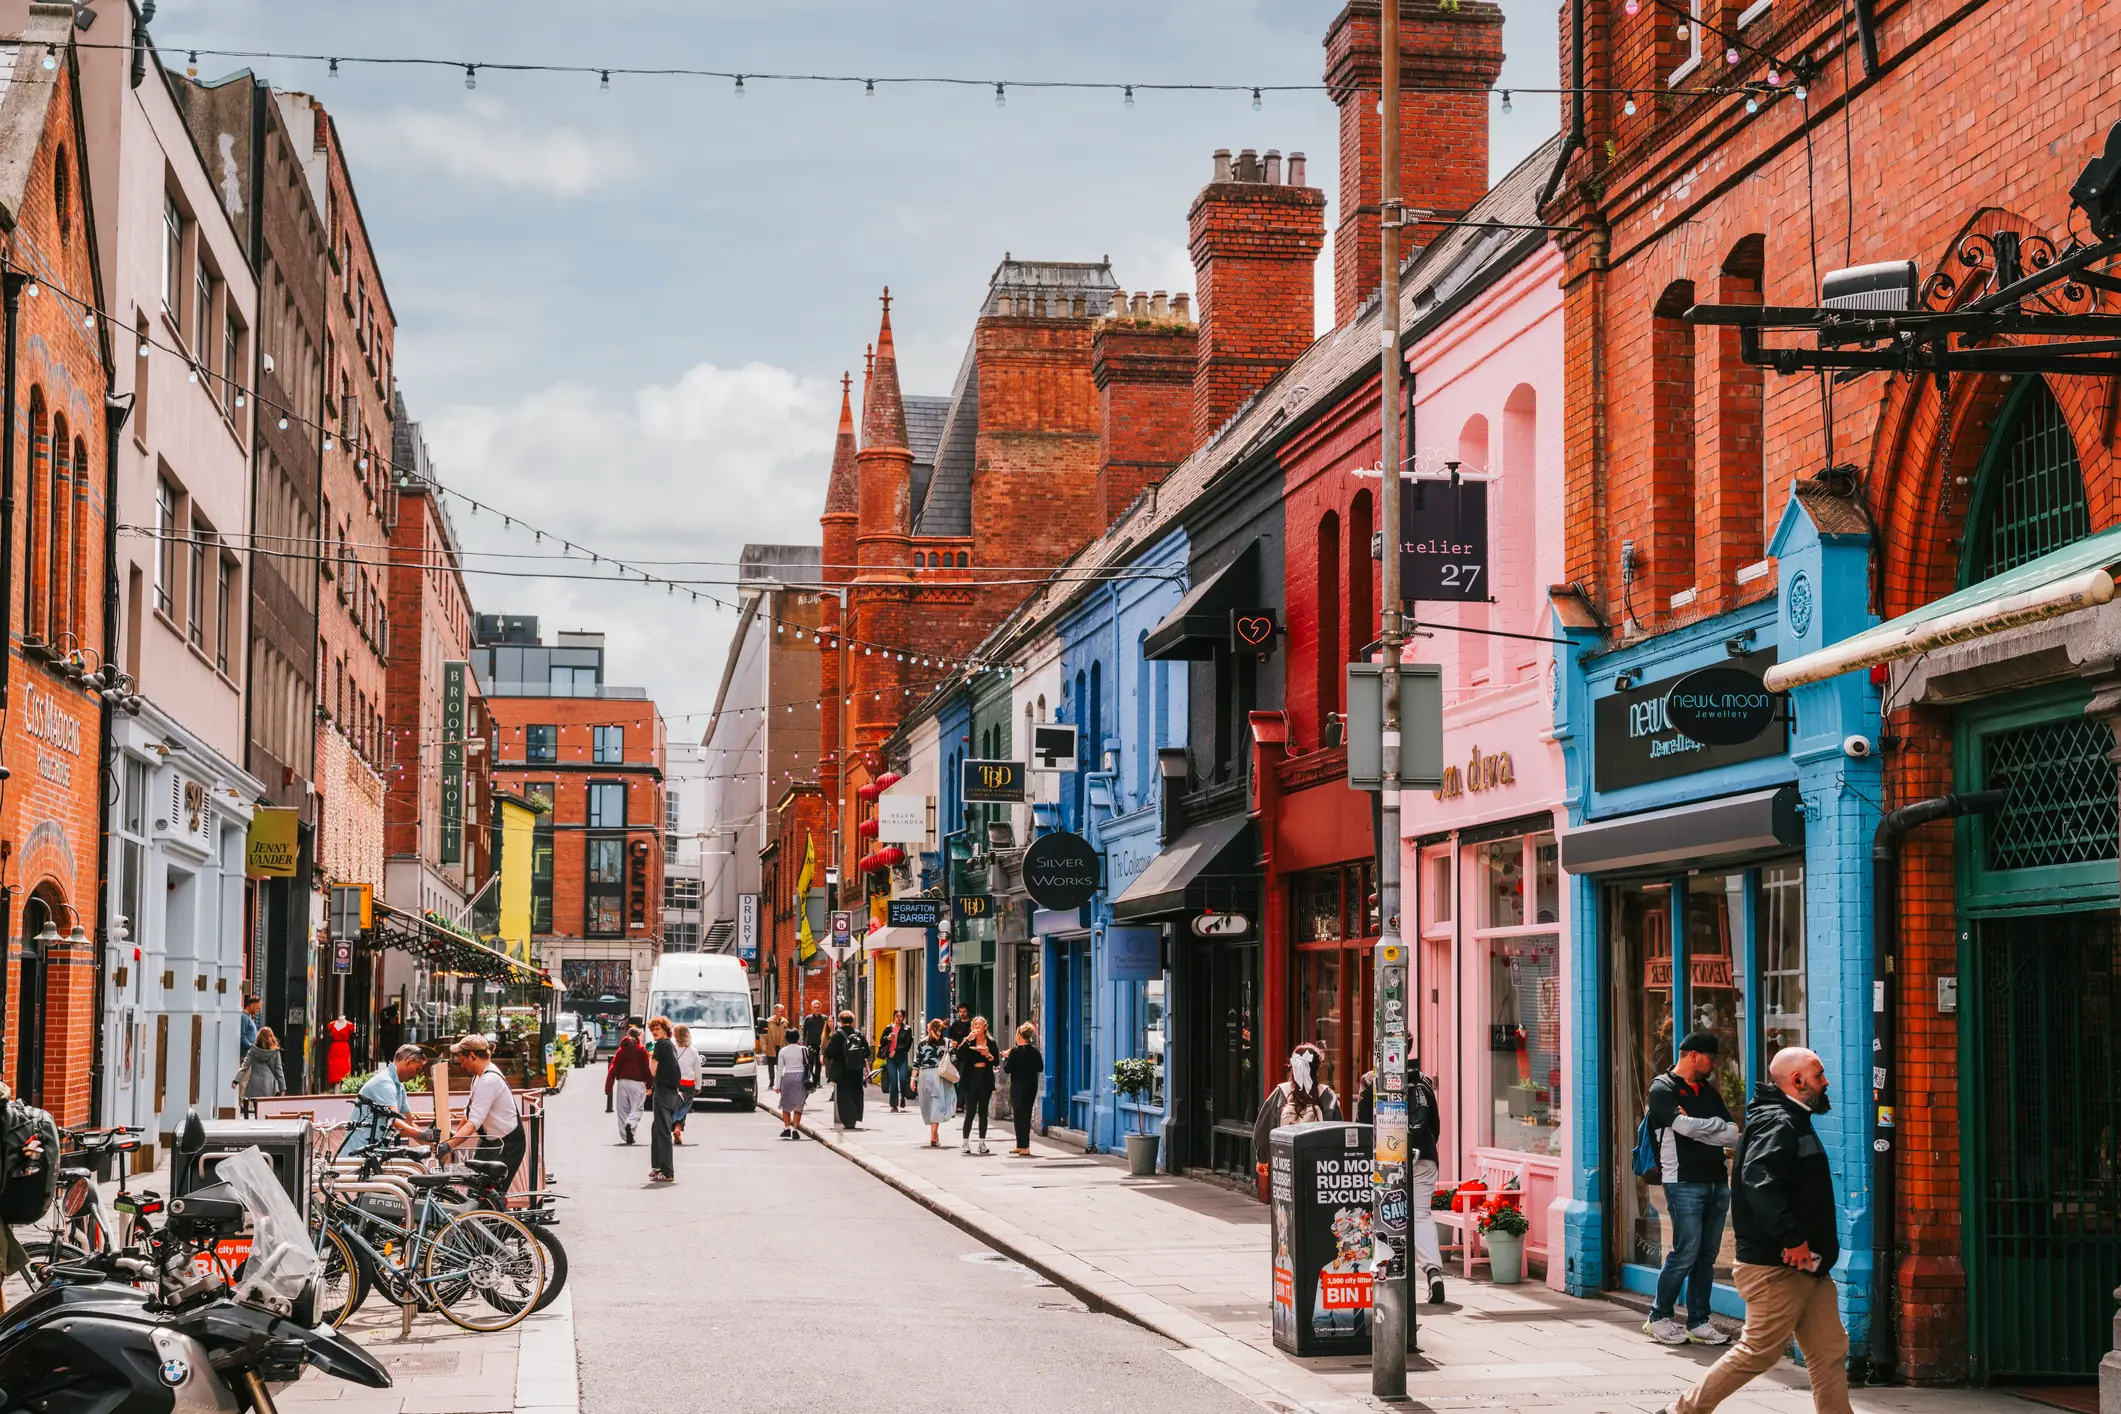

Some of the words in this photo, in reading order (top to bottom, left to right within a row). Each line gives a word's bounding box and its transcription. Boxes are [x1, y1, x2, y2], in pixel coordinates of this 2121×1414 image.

[1399, 540, 1473, 554] telier
[1441, 564, 1481, 593] 27
[1673, 695, 1709, 708] new
[1721, 694, 1769, 708] moon
[448, 670, 459, 760] BROOKS
[1630, 697, 1664, 738] new
[1695, 710, 1748, 719] Jewellery
[978, 765, 1012, 789] TBD
[1433, 765, 1462, 800] m
[1467, 744, 1515, 792] diva
[446, 774, 458, 850] HOTEL
[253, 842, 290, 854] JENNY
[249, 854, 293, 866] VANDER
[1036, 856, 1084, 868] SILVER
[1112, 853, 1123, 879] The
[1032, 875, 1093, 887] WORKS
[900, 904, 935, 913] GRAFTON
[959, 897, 985, 916] TBD
[743, 895, 752, 943] DRURY
[900, 913, 936, 923] BARBER
[740, 949, 748, 959] P
[1272, 1156, 1279, 1169] NO
[1278, 1157, 1291, 1172] MORE
[1316, 1160, 1340, 1174] NO
[1343, 1159, 1374, 1173] MO
[1272, 1170, 1291, 1187] RUBBISH
[1316, 1174, 1374, 1189] RUBBI
[1317, 1189, 1375, 1204] EXCUS
[218, 1245, 234, 1255] city
[235, 1245, 252, 1254] litt
[192, 1258, 237, 1279] BIN
[1345, 1277, 1356, 1285] city
[1276, 1281, 1285, 1297] BIN
[1326, 1287, 1359, 1303] BIN
[1365, 1286, 1373, 1302] I
